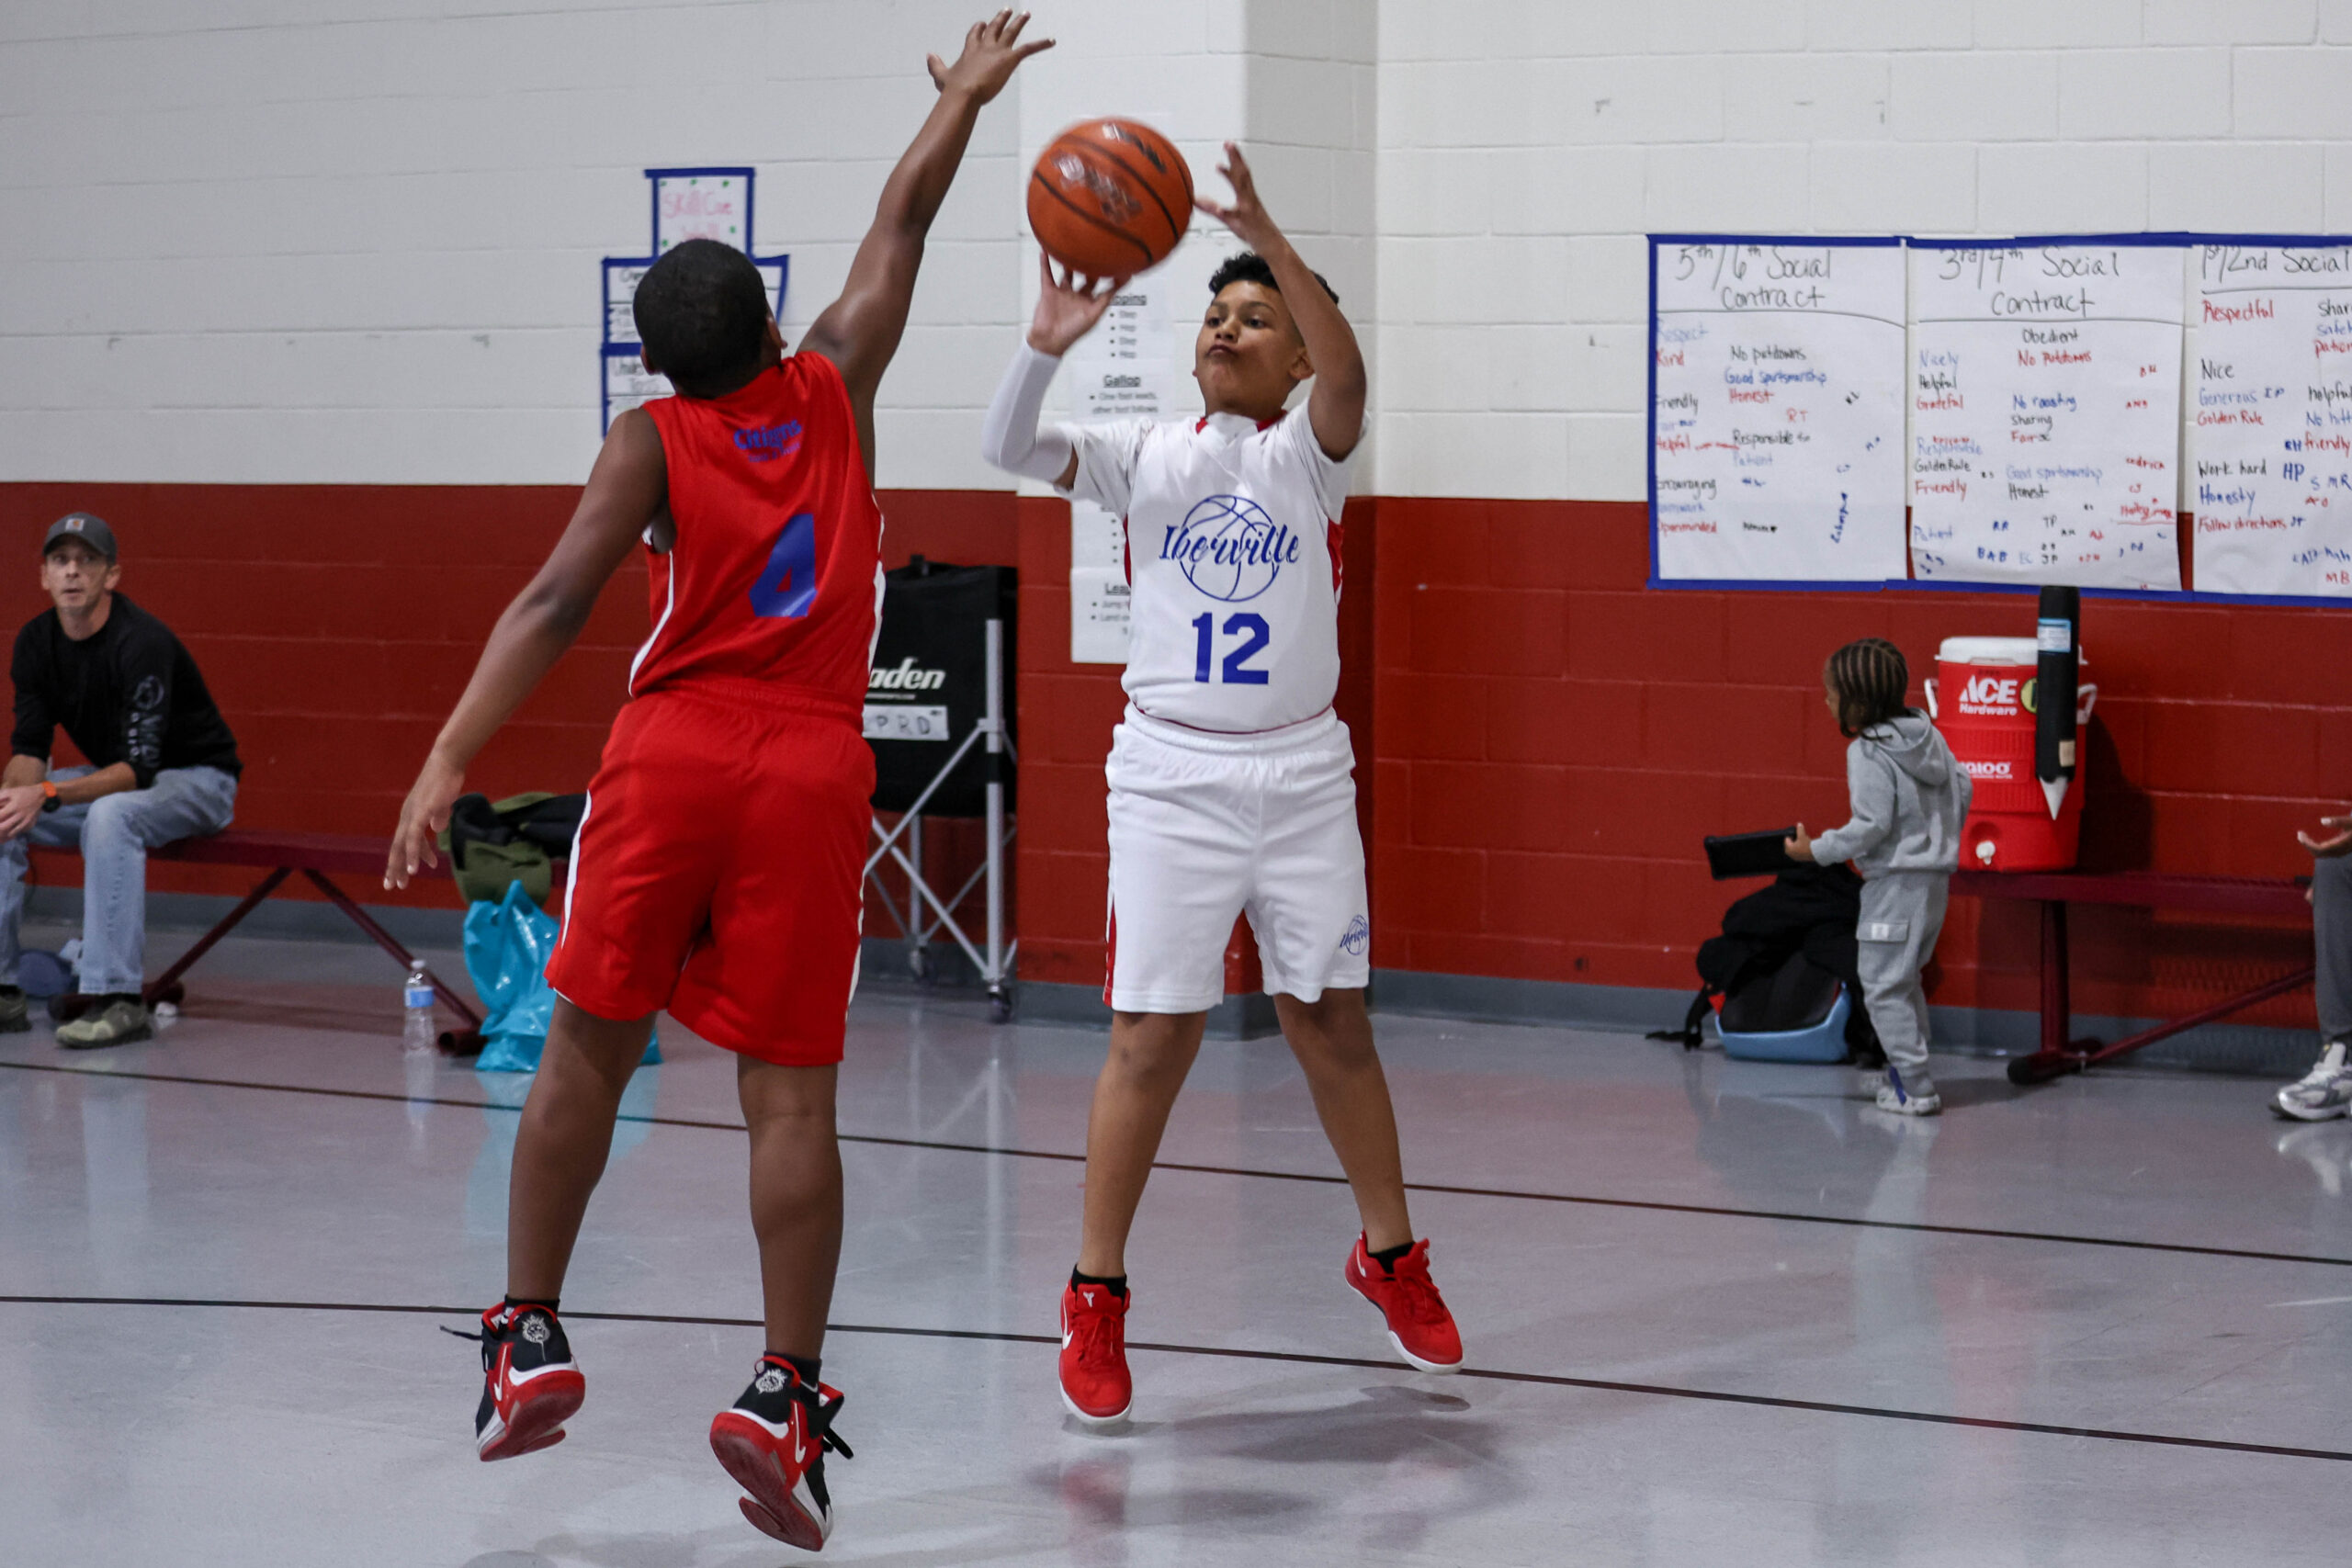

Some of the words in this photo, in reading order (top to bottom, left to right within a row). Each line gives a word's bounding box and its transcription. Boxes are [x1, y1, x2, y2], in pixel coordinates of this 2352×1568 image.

[1766, 245, 1832, 280] Social
[2042, 246, 2120, 277] Social
[2281, 247, 2351, 274] Social
[1722, 285, 1826, 310] Contract
[1992, 287, 2096, 318] Contract
[2201, 299, 2275, 325] Respectful
[2022, 322, 2079, 344] Obedient
[1729, 344, 1748, 362] No
[1918, 350, 1960, 375] Nicely
[2017, 349, 2037, 367] No
[1724, 365, 1754, 385] Good
[2200, 357, 2235, 381] Nice
[1728, 387, 1775, 404] Honest
[2197, 411, 2238, 426] Golden
[2240, 409, 2265, 426] Rule
[2306, 411, 2324, 427] No
[1732, 428, 1794, 450] Responsible
[2304, 431, 2351, 458] friendly
[2197, 460, 2233, 479] Work
[2239, 457, 2267, 476] hard
[1915, 478, 1968, 502] Friendly
[2008, 482, 2051, 501] Honest
[2199, 482, 2256, 517] Honesty
[1159, 524, 1301, 566] Iberville
[748, 513, 818, 618] 4
[1192, 612, 1270, 684] 12
[867, 657, 947, 690] aden
[1959, 674, 2018, 705] ACE
[1959, 703, 2018, 716] Hardware
